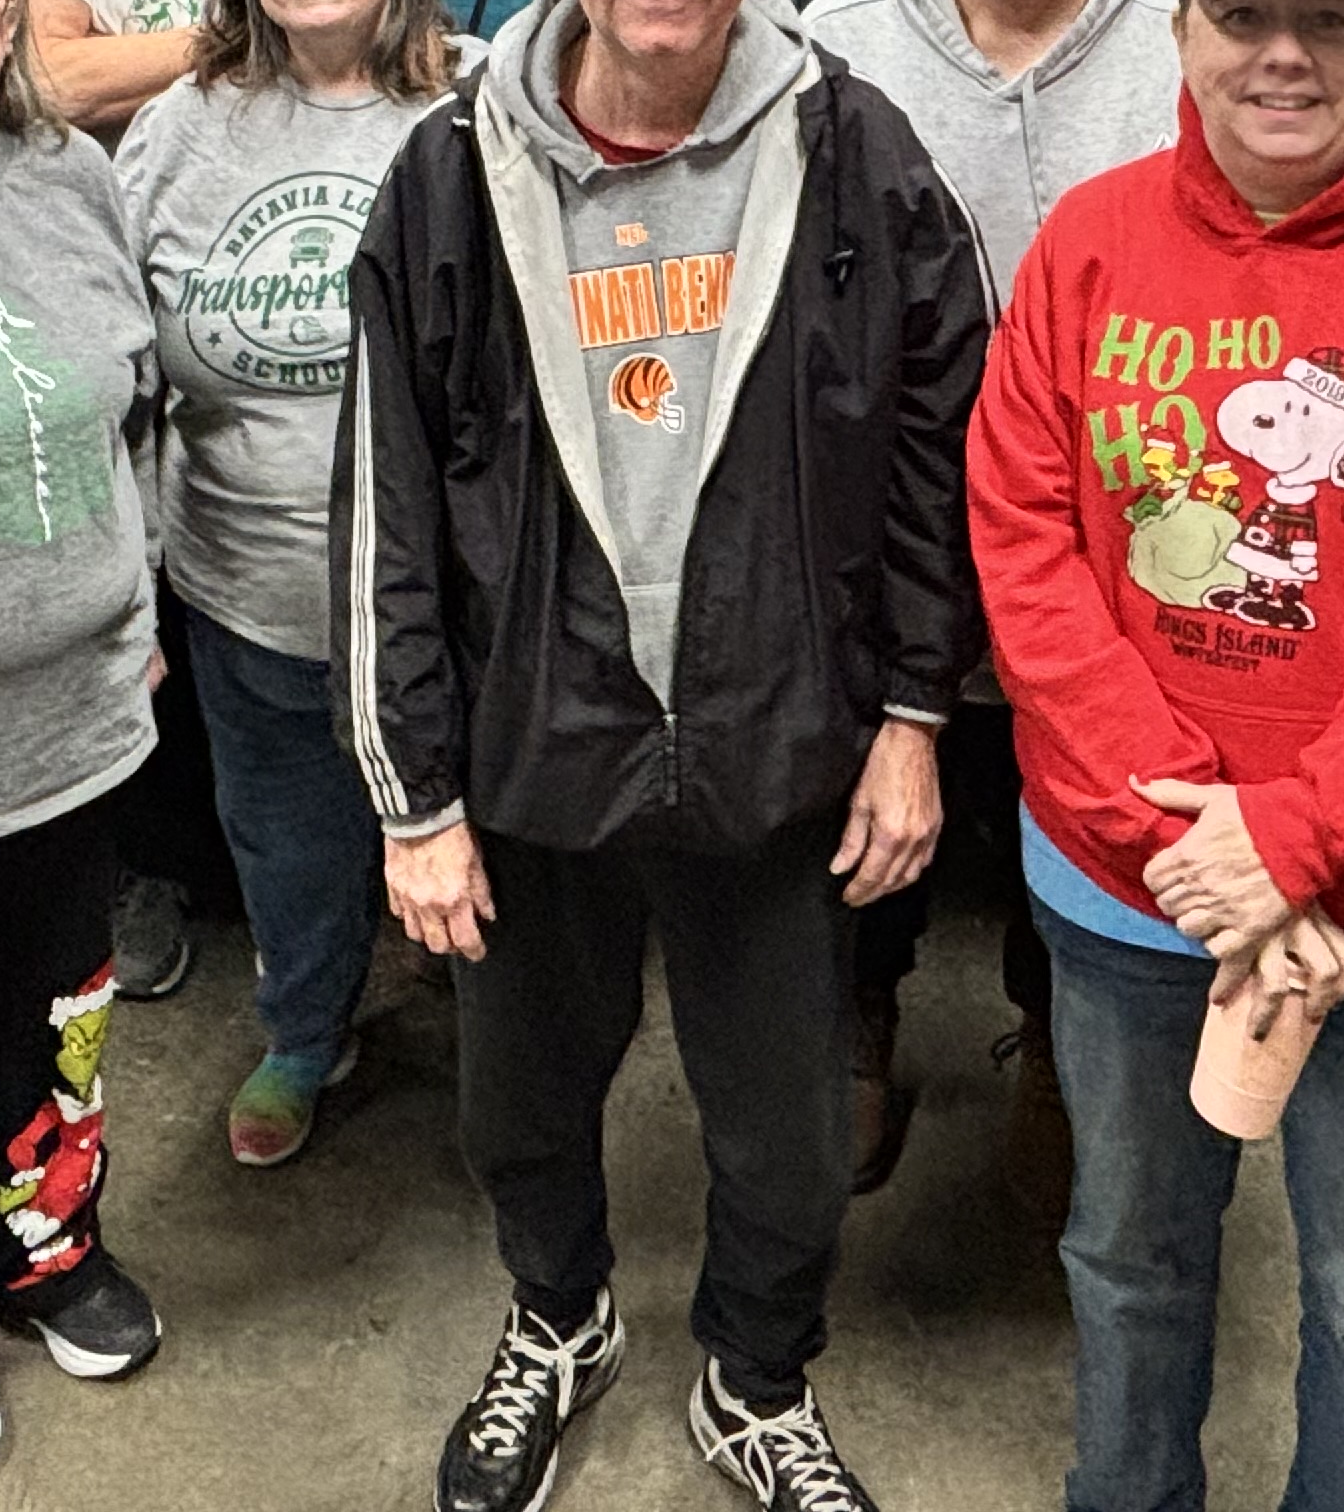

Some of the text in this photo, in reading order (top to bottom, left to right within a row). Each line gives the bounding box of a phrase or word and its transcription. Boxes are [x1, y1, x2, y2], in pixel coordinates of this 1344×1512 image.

[224, 185, 373, 258] BATAVIA LO
[176, 264, 351, 330] Transport
[568, 262, 661, 347] INATI
[232, 349, 343, 386] SCHOO
[1091, 313, 1282, 392] HO HO
[1087, 394, 1208, 493] HO
[1214, 621, 1302, 661] ISLAND
